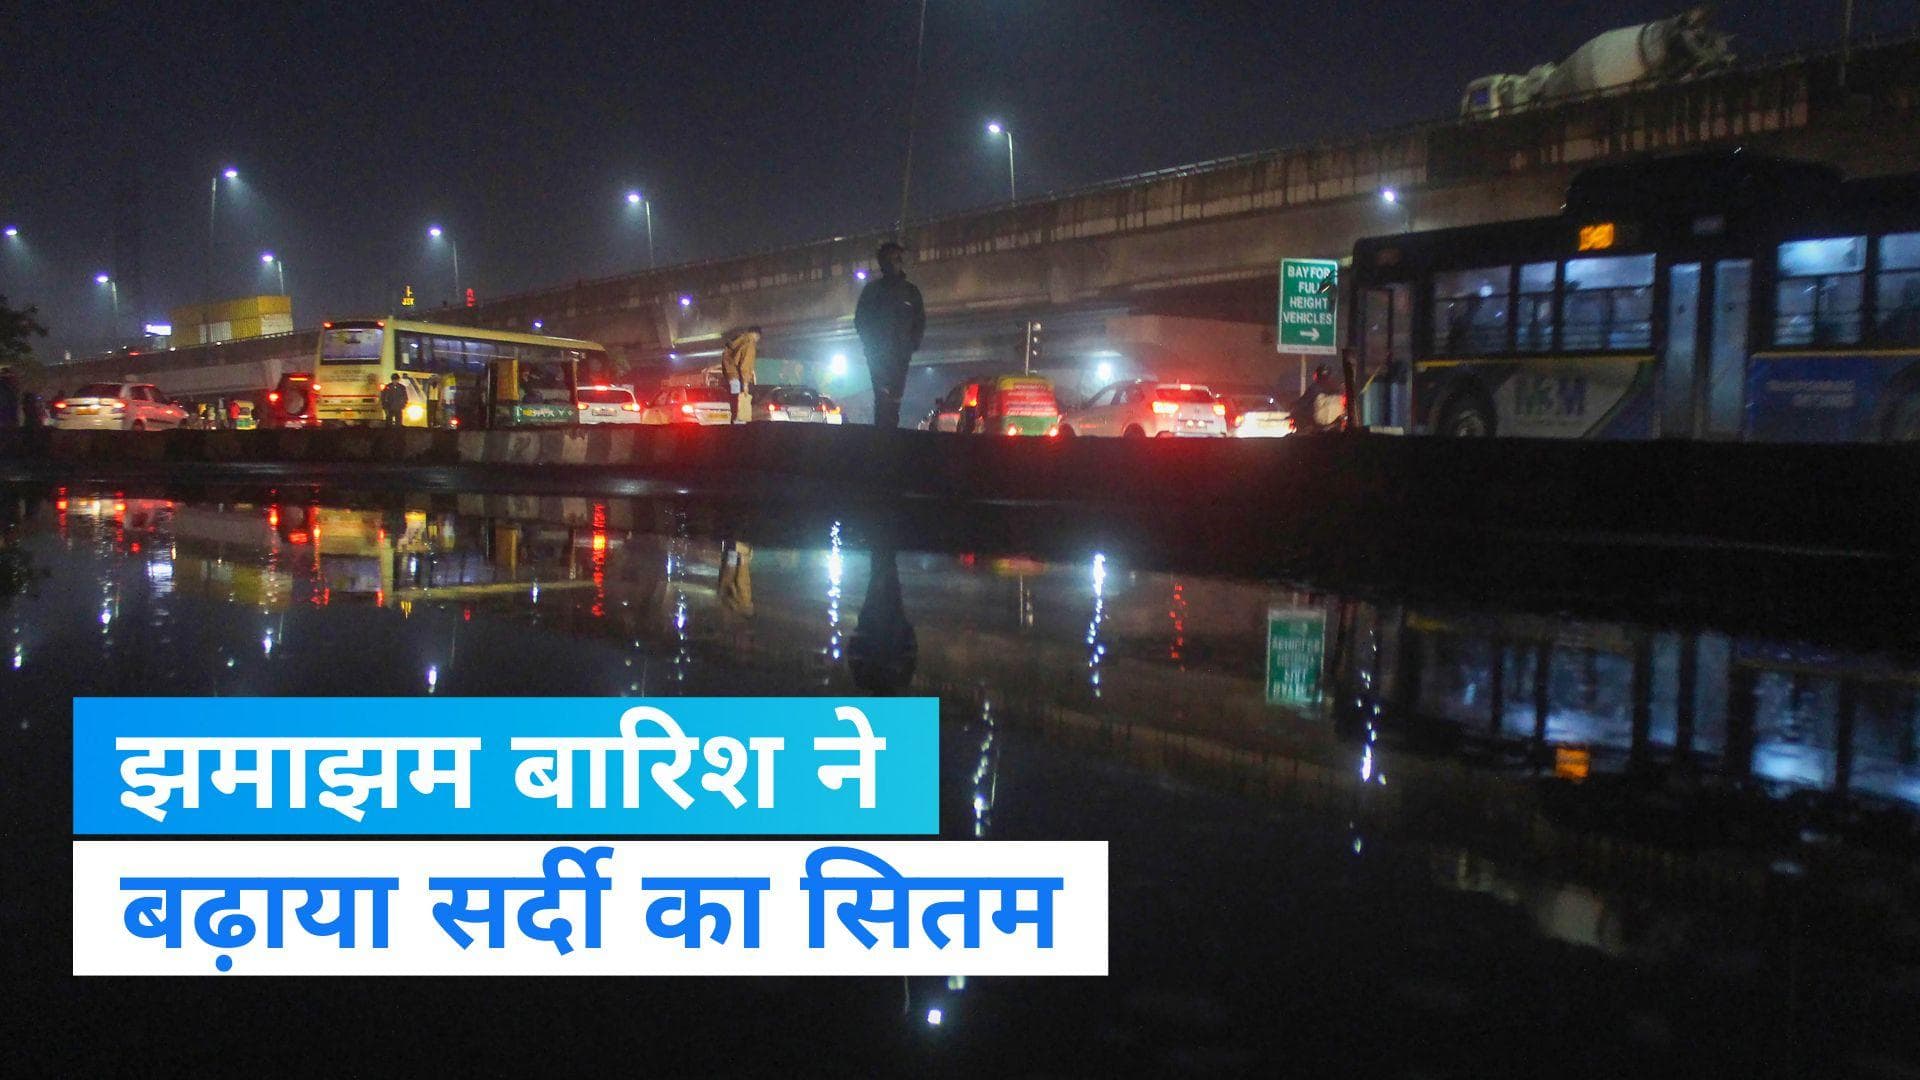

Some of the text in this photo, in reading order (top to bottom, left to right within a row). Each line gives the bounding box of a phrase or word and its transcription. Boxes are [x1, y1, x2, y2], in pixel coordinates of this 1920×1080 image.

[1287, 265, 1330, 279] BAY FOR
[1289, 297, 1328, 309] HEIGHT
[1283, 311, 1332, 324] VEHICLES
